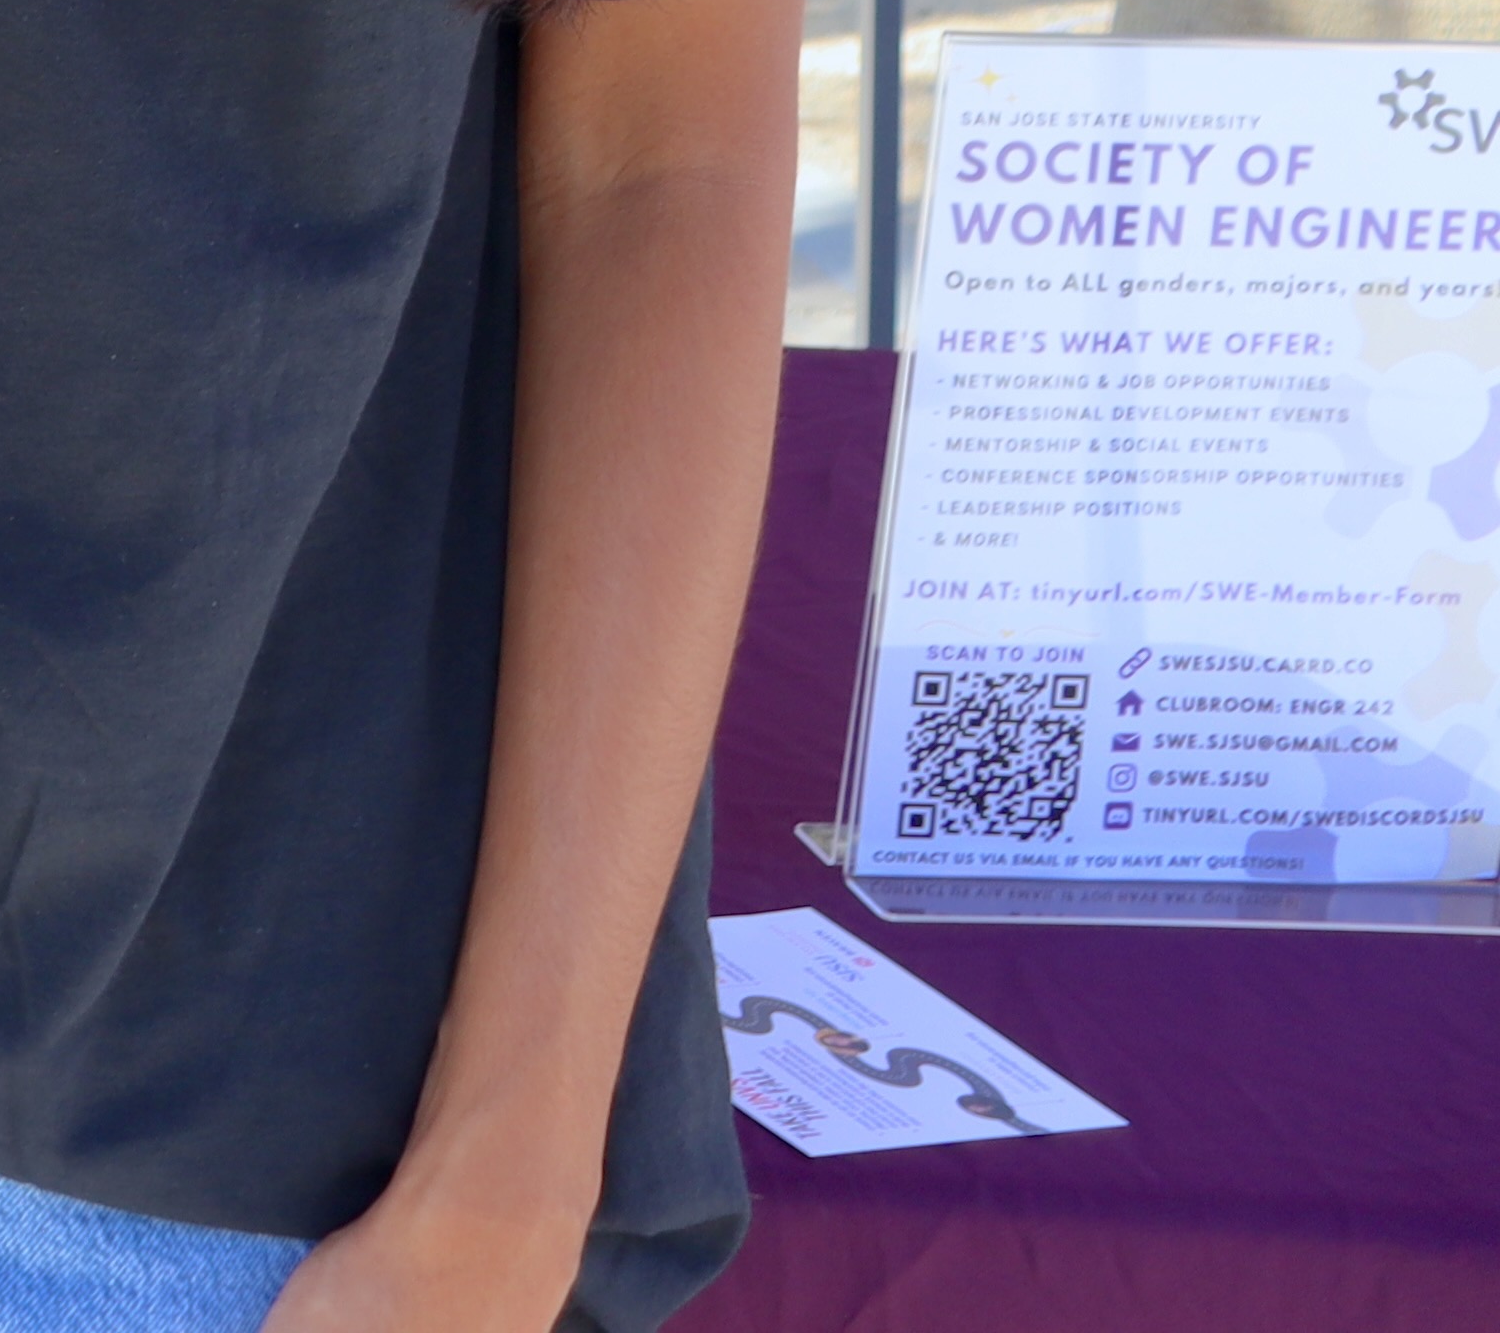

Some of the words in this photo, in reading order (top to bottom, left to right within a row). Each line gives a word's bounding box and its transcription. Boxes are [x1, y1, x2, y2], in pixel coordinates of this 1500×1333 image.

[960, 111, 1001, 128] SAN
[1008, 111, 1058, 129] JOSE
[1067, 112, 1131, 129] STATE
[1138, 113, 1262, 132] UNIVERSITY
[955, 141, 1215, 185] SOCIETY
[1236, 144, 1315, 187] OF
[950, 204, 1184, 248] WOMEN
[1209, 206, 1500, 252] ENGINEER
[944, 270, 1013, 296] Open
[1026, 274, 1051, 293] to
[1062, 273, 1109, 293] ALL
[1118, 274, 1235, 299] genders,
[1247, 277, 1347, 300] majors,
[1358, 276, 1410, 297] and
[1060, 331, 1151, 354] WHAT
[1165, 332, 1212, 355] WE
[1225, 333, 1334, 357] OFFER:
[953, 374, 1089, 389] NETWORKING
[1098, 374, 1110, 390] &
[1116, 375, 1156, 389] JOB
[1164, 375, 1332, 392] OPPORTUNITIES
[949, 406, 1103, 421] PROFESSIONAL
[1112, 406, 1262, 422] DEVELOPMENT
[1270, 408, 1350, 423] EVENTS
[945, 437, 1081, 452] MENTORSHIP
[1088, 438, 1102, 453] &
[1109, 438, 1181, 453] SOCIAL
[1189, 438, 1269, 453] EVENTS
[941, 468, 1077, 484] CONFERENCE
[1085, 469, 1229, 485] SPONSORSHIP
[1236, 470, 1405, 488] OPPORTUNITIES
[936, 500, 1066, 516] LEADERSHIP
[1073, 501, 1182, 516] POSITIONS
[932, 531, 948, 547] &
[954, 532, 1019, 547] MORE!
[903, 580, 969, 600] JOIN
[977, 582, 1021, 600] AT:
[926, 646, 987, 661] SCAN
[997, 647, 1025, 662] TO
[1033, 647, 1085, 663] JOIN
[1156, 696, 1282, 714] CLUBROOM:
[1290, 698, 1346, 715] ENGR
[1353, 700, 1394, 716] 242
[1148, 770, 1270, 788] @SWE.SJSU
[872, 850, 948, 865] CONTACT
[954, 852, 975, 866] US
[980, 853, 1006, 866] VIA
[1012, 853, 1060, 867] EMAIL
[1065, 855, 1079, 867] IF
[1084, 855, 1118, 868] YOU
[1122, 856, 1164, 869] HAVE
[1169, 856, 1202, 869] ANY
[1207, 857, 1304, 871] QUESTIONS!
